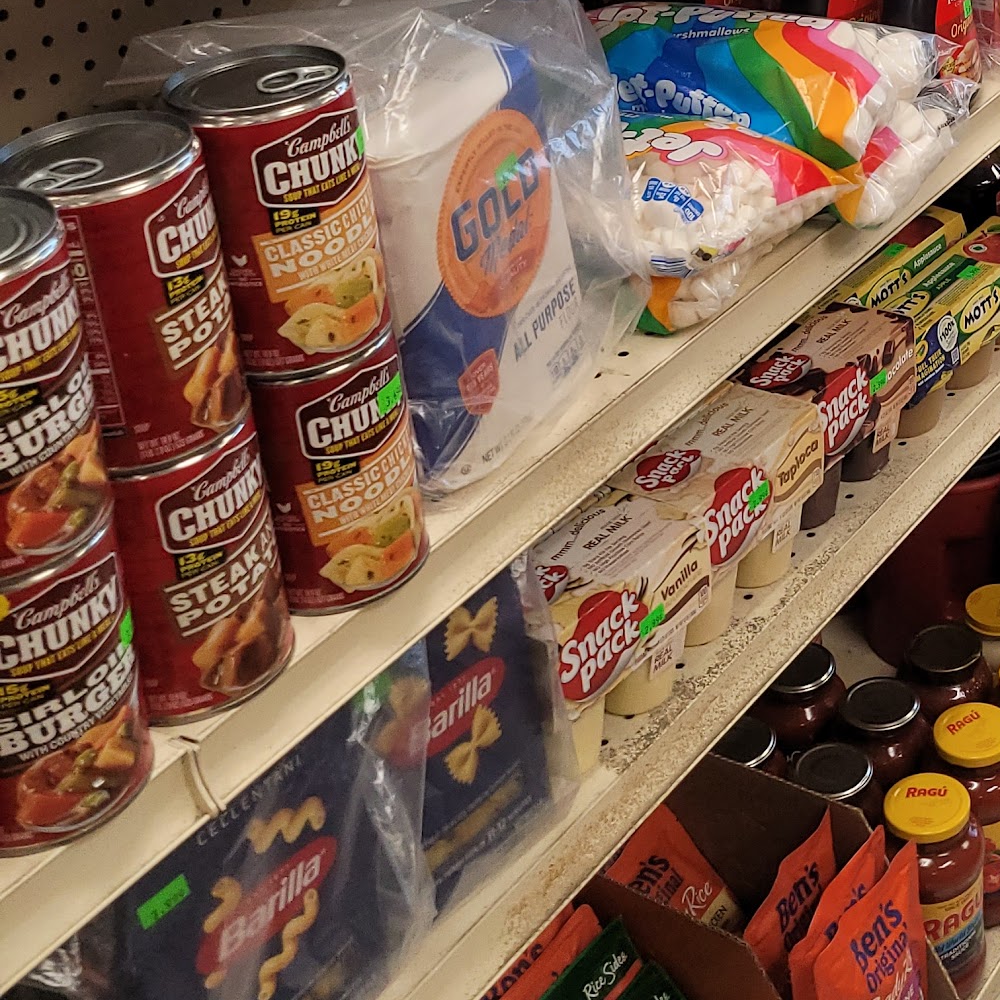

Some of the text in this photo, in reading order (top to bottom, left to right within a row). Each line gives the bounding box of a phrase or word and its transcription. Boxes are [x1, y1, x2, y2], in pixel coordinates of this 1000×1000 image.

[284, 114, 352, 158] Campbell's
[264, 221, 343, 264] CLASSIC
[912, 242, 943, 270] Applesauce
[871, 271, 909, 308] MOTT'S
[963, 288, 1000, 331] MOTT'S
[513, 329, 533, 364] ALL
[531, 277, 578, 345] PURPOSE
[327, 366, 391, 412] Campbell's
[749, 353, 794, 388] Snack
[774, 356, 806, 383] pack
[712, 405, 754, 438] REAL MILK
[817, 367, 869, 430] Snack
[827, 393, 871, 449] pack
[193, 450, 252, 499] Campbell's
[636, 447, 687, 489] Snack
[663, 455, 697, 485] pack
[776, 437, 820, 487] Tapioca
[168, 457, 264, 542] CHUNKY
[307, 470, 383, 511] CLASSIC
[703, 465, 767, 543] Snack
[582, 513, 632, 551] REAL MILK
[15, 569, 102, 630] Campbell's
[172, 548, 259, 613] STEAK
[660, 559, 699, 603] Vanilla
[560, 589, 641, 685] Snack
[579, 614, 642, 694] pack
[408, 670, 493, 748] Barilla
[946, 709, 982, 737] RAGÚ
[905, 785, 949, 799] RAGÚ
[218, 852, 322, 961] Barilla
[682, 880, 714, 916] Rice
[775, 861, 821, 934] Ben's
[850, 898, 904, 973] Ben's
[581, 951, 629, 1000] Rice Sides
